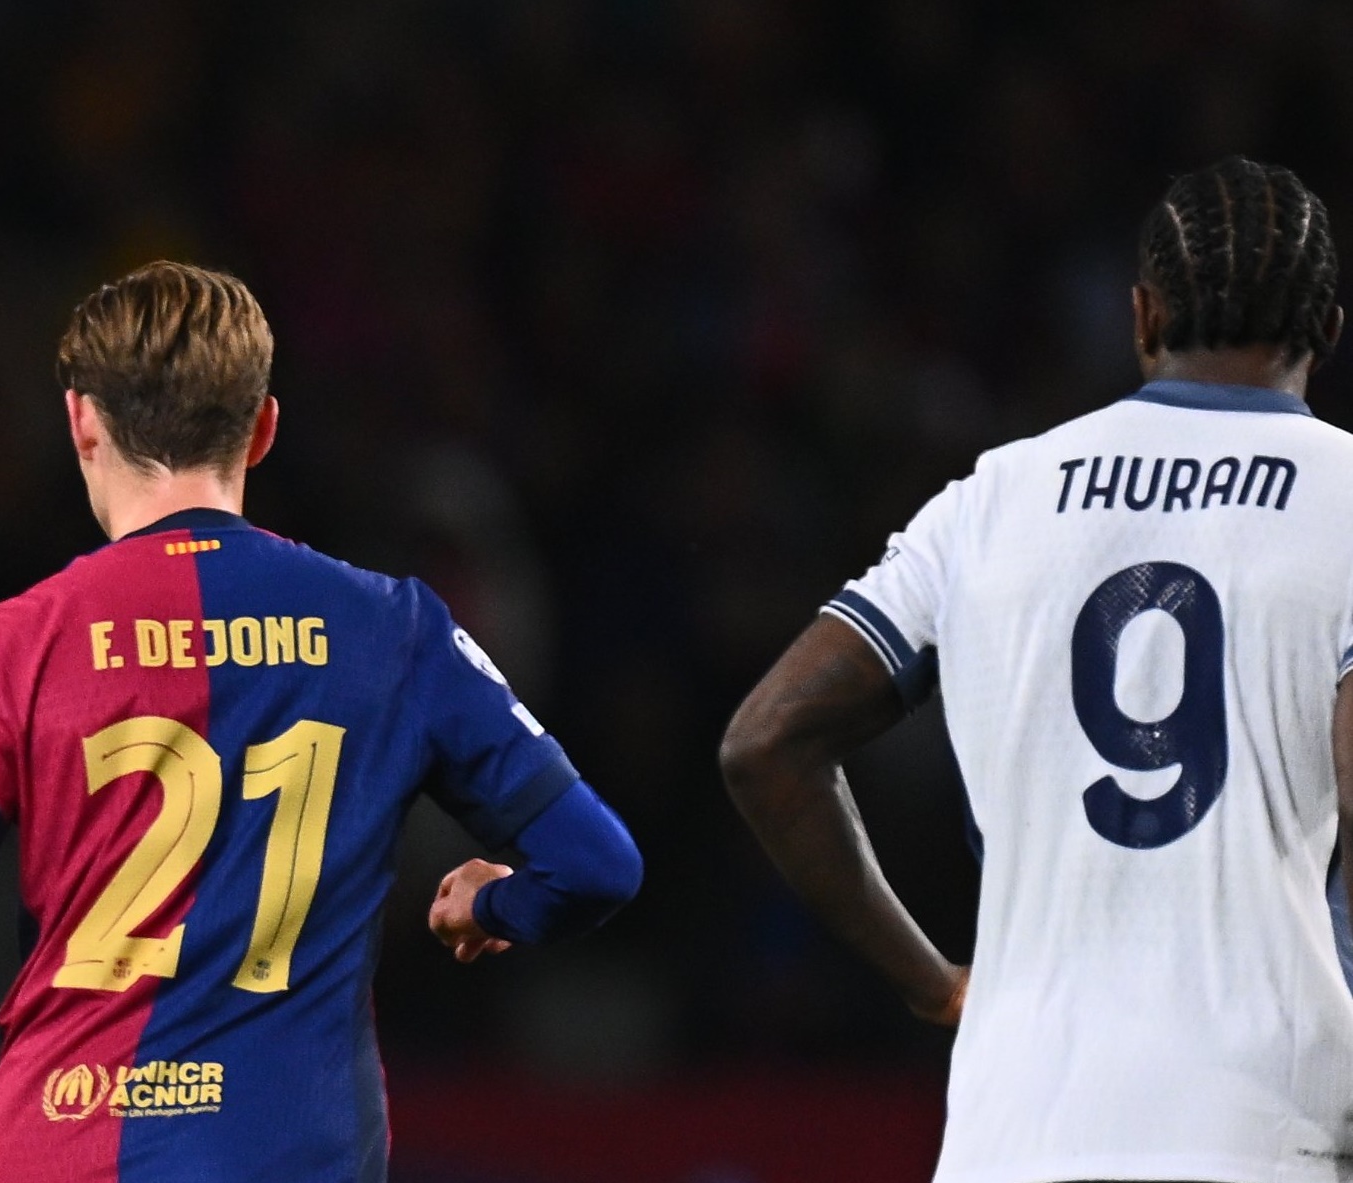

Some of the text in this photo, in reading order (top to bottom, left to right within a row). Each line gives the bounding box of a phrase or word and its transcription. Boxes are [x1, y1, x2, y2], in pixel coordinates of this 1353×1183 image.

[1056, 455, 1297, 514] THURAM
[90, 621, 124, 670] F.
[202, 616, 328, 666] JONG
[1071, 560, 1230, 850] 9
[51, 715, 347, 995] 21
[108, 1084, 222, 1107] ACNUR
[116, 1061, 224, 1085] UNHCR
